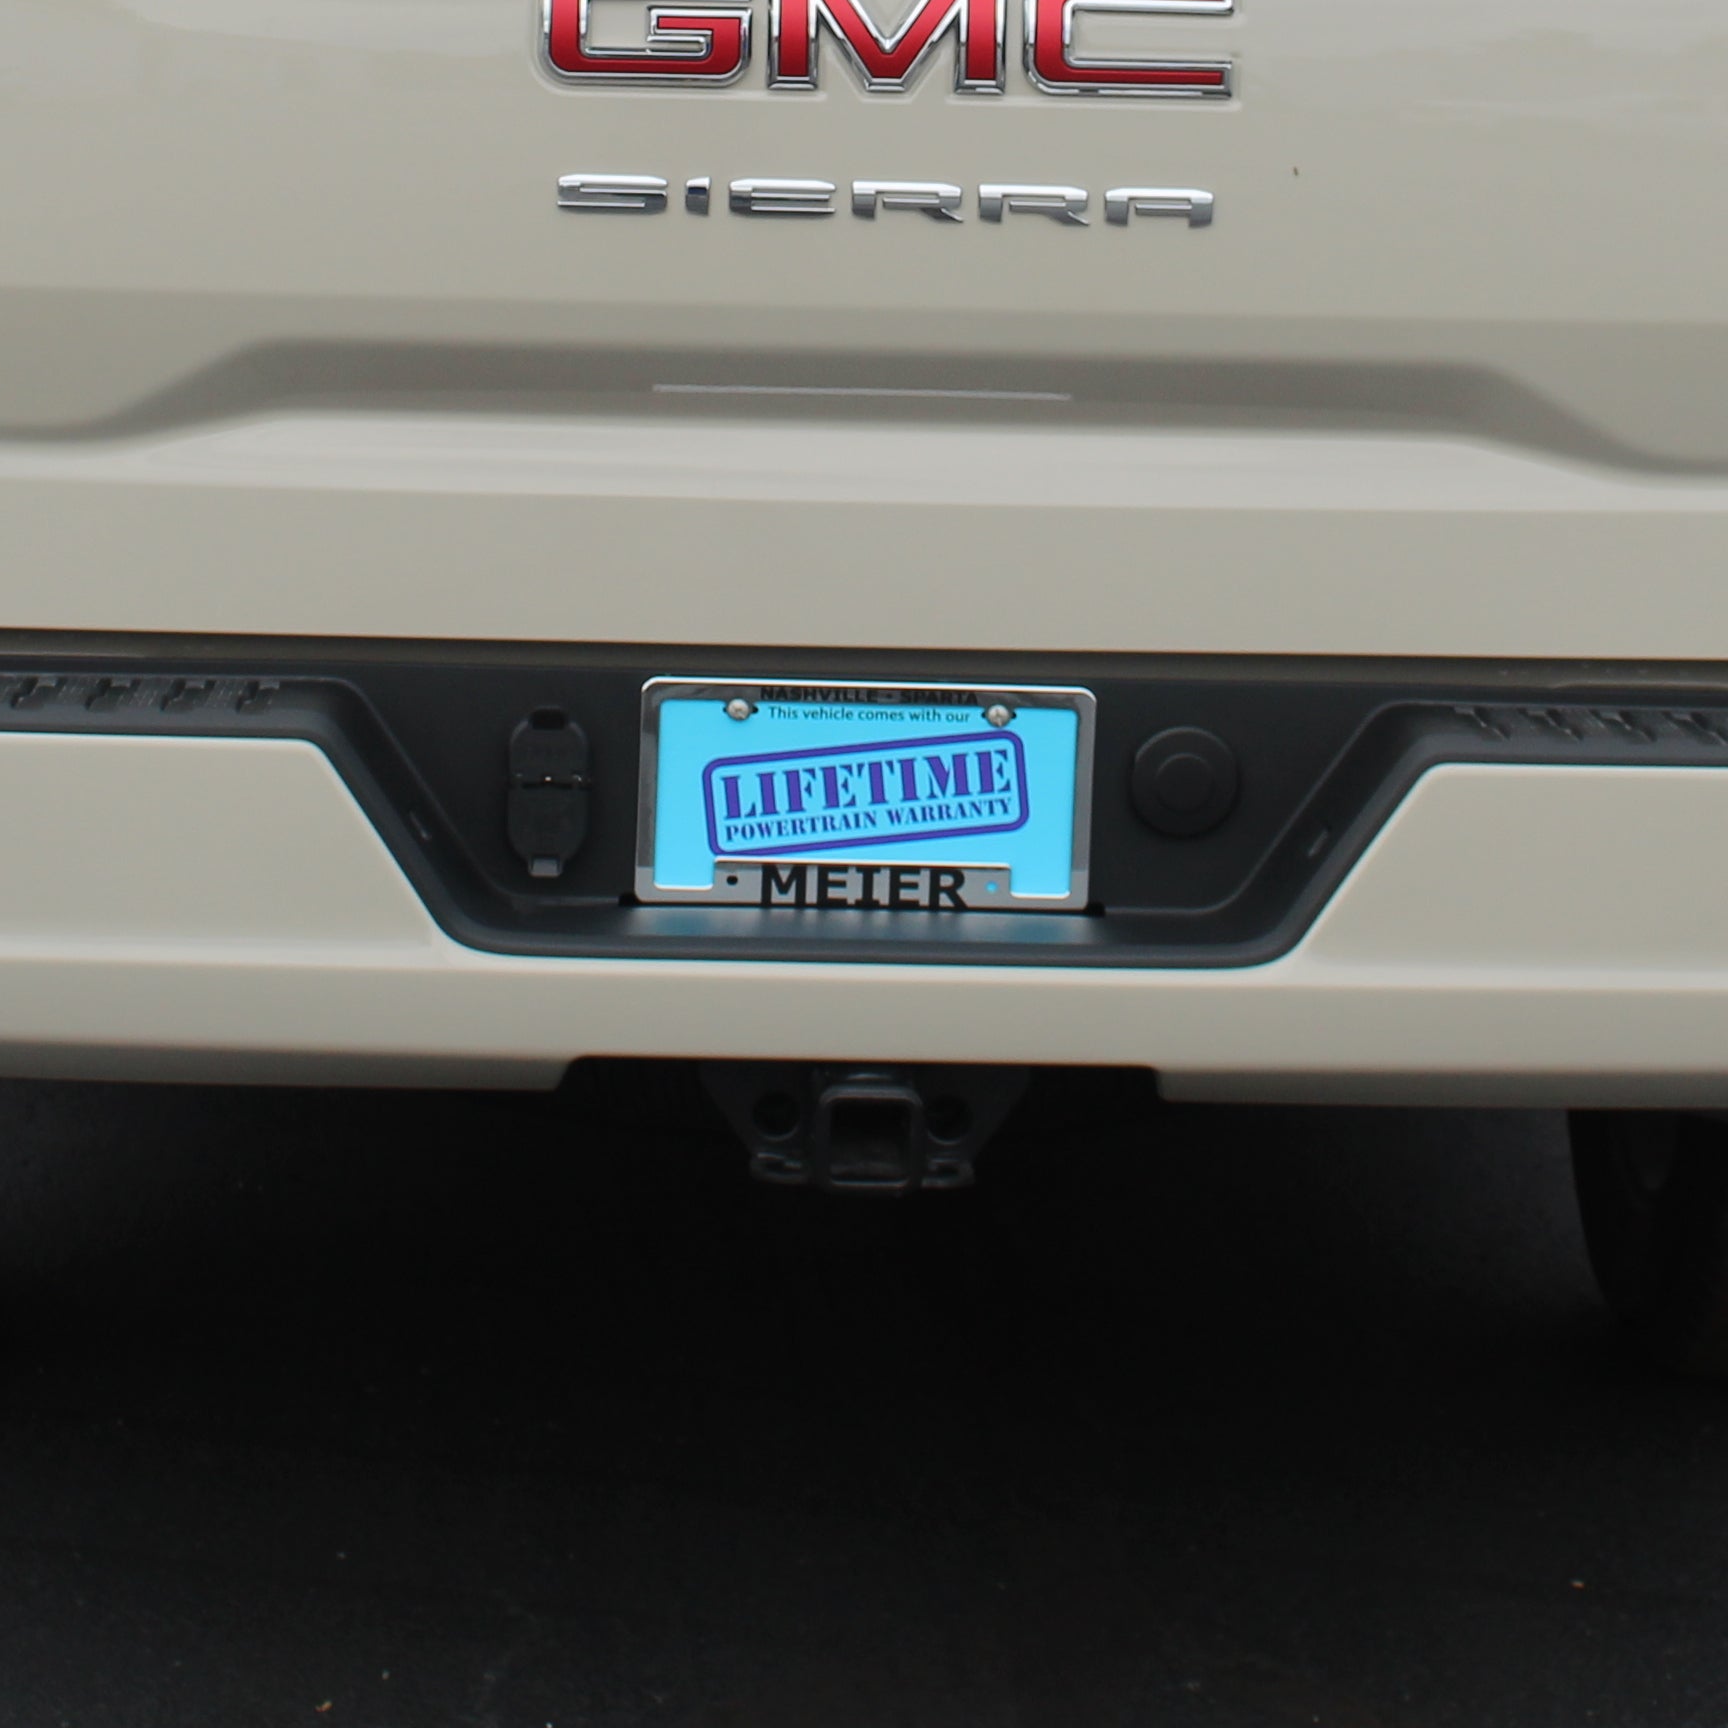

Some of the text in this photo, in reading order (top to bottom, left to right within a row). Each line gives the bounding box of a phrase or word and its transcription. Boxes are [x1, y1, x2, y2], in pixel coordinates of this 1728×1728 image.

[557, 174, 1214, 227] SIERRA
[760, 686, 979, 706] NASHVILLE SPARTA
[769, 706, 970, 723] This vehicle comes with our
[721, 749, 1013, 820] LIFETIME
[725, 798, 1013, 842] POWERTRAIN WARRANTY
[760, 863, 968, 910] MEIER
